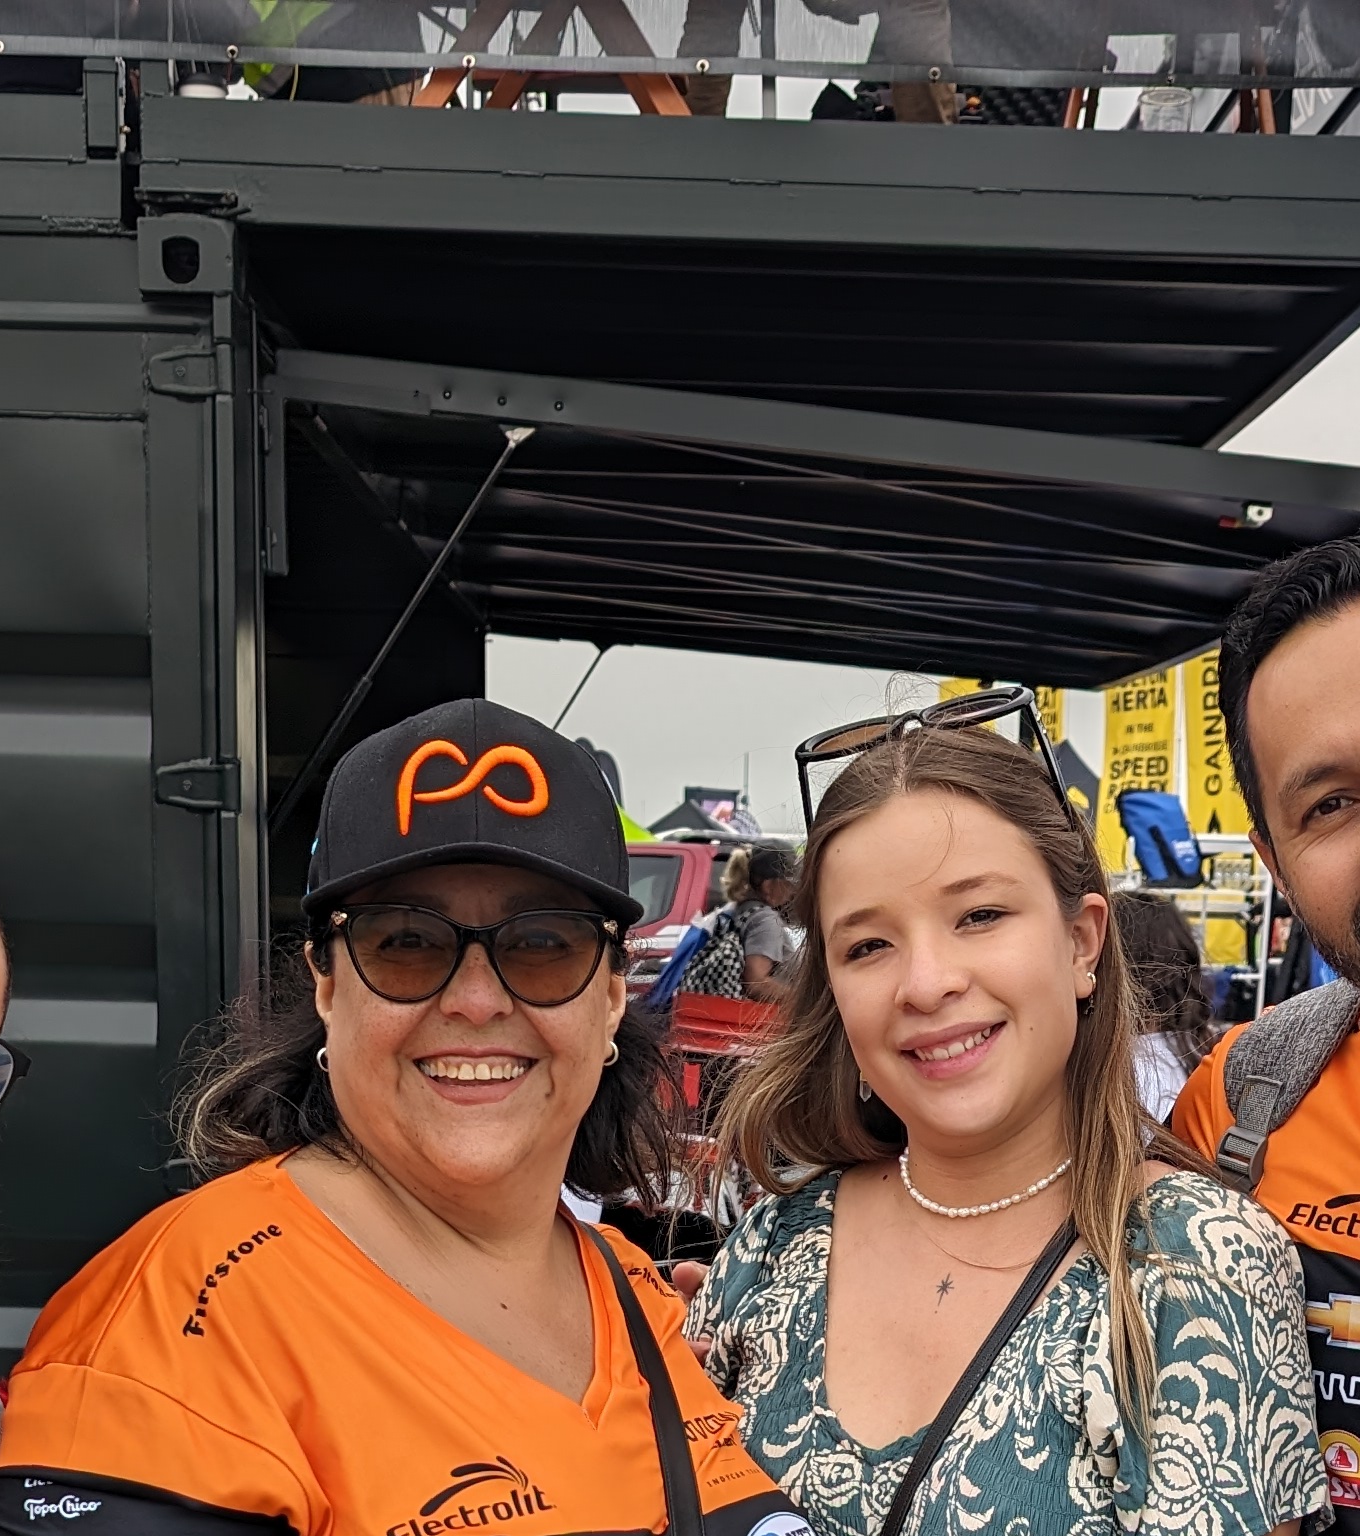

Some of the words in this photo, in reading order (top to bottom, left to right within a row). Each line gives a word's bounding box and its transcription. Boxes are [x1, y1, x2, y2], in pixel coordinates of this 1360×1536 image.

[1110, 686, 1169, 714] HERTA
[1110, 755, 1169, 780] SPEED
[182, 1222, 284, 1338] Firestone
